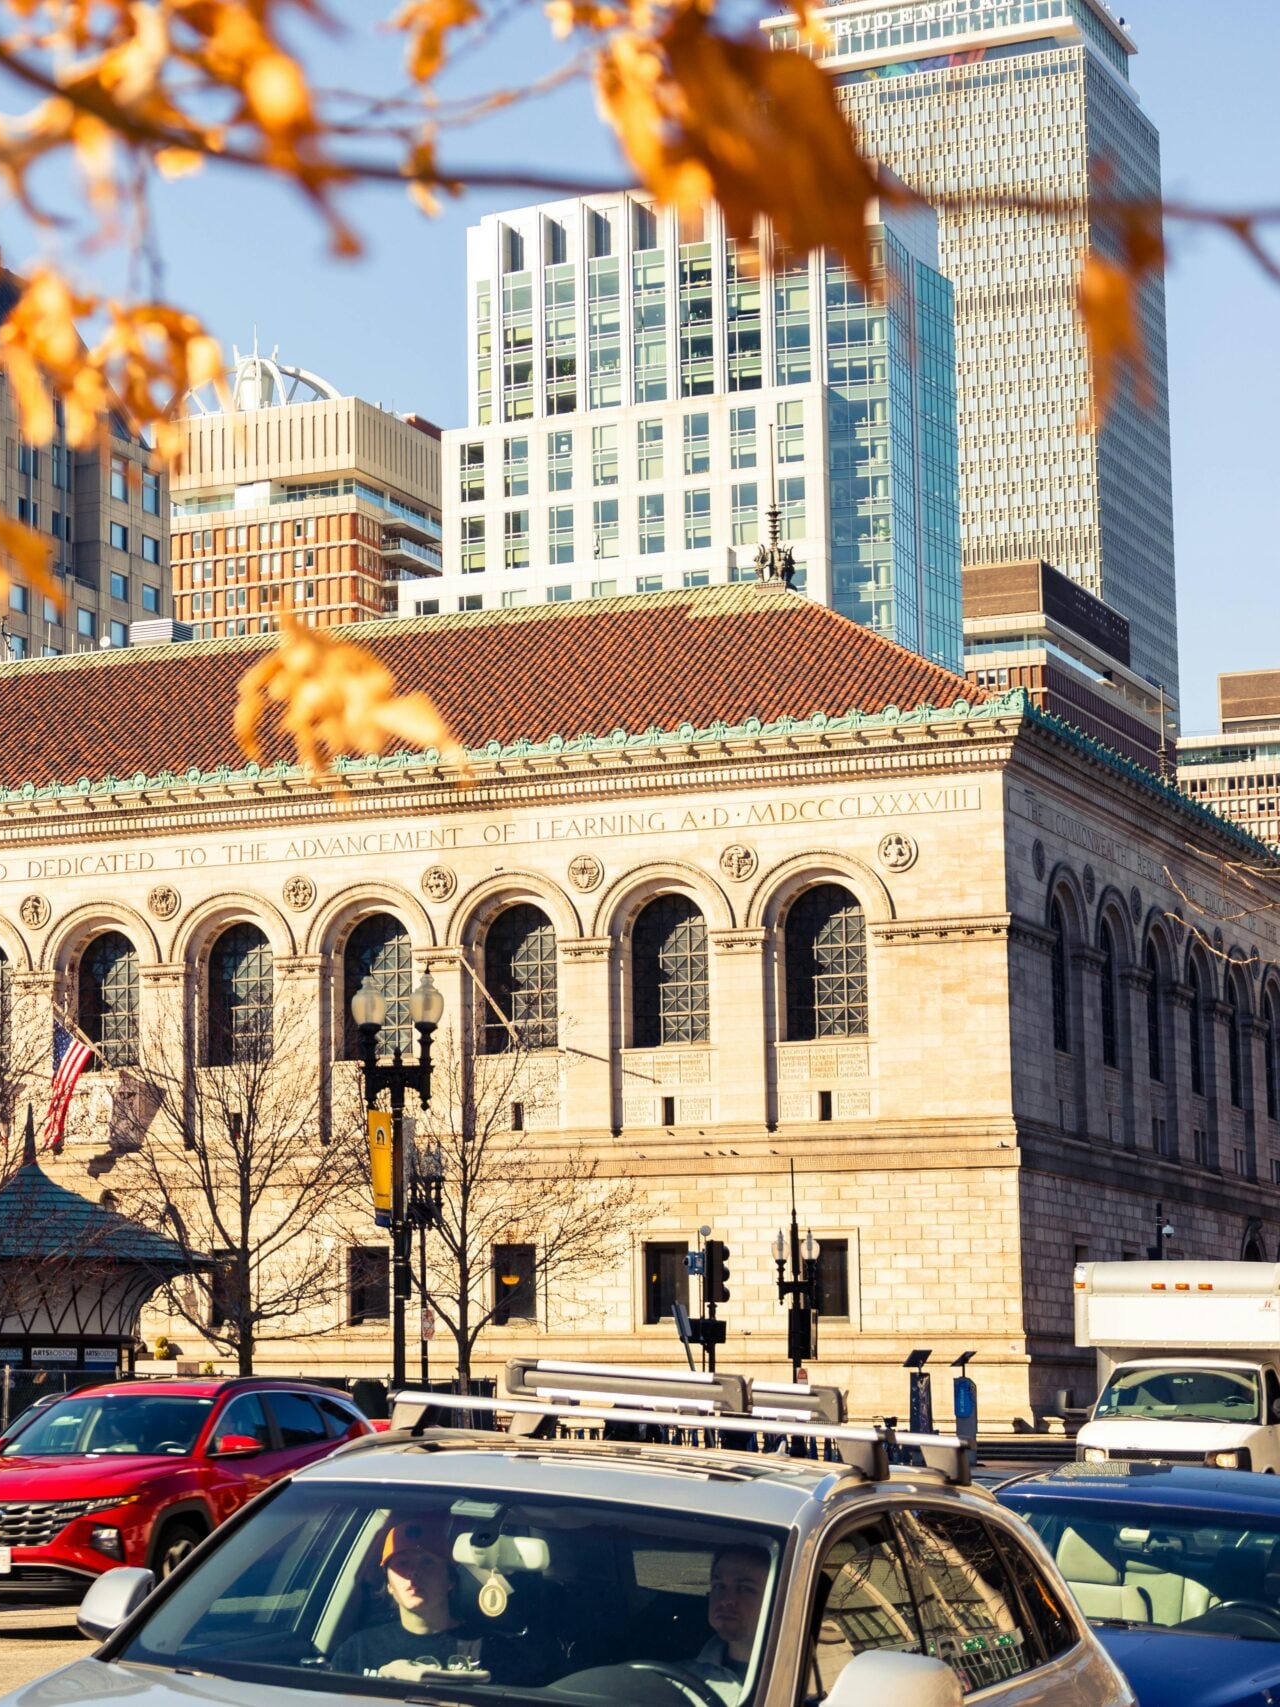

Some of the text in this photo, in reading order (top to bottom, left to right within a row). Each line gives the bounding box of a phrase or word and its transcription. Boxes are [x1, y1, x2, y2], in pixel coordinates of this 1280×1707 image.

[28, 852, 155, 878] DEDICATED
[175, 848, 207, 866] TO
[222, 843, 271, 864] THE
[284, 828, 464, 858] ADVANCEMENT
[483, 824, 517, 843] OF
[536, 812, 665, 840] LEARNING
[1025, 798, 1044, 826] THE
[1055, 814, 1127, 863] COMMONWEALTH
[32, 1349, 77, 1357] ARTSBOSTON
